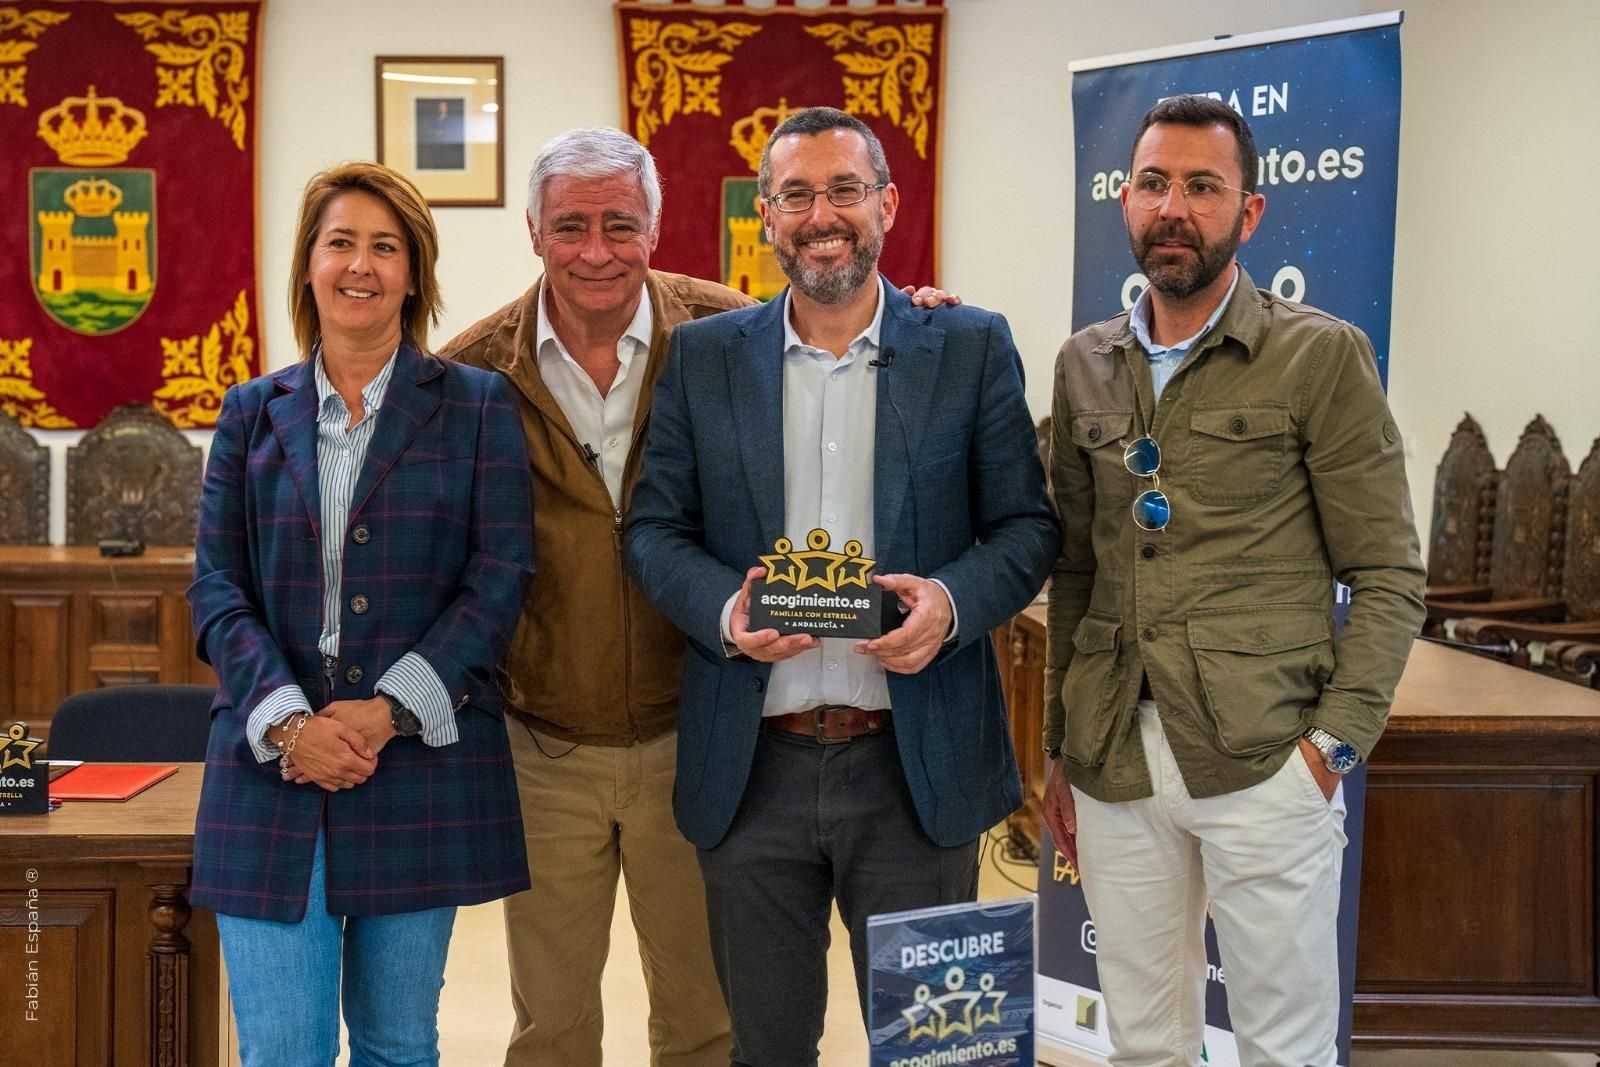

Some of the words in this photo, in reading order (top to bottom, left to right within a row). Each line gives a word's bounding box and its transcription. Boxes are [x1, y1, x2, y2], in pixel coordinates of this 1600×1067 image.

[1252, 82, 1289, 117] EN
[761, 593, 871, 609] acogimiento.es
[770, 609, 804, 618] FAMILIAS
[823, 612, 858, 620] ESTRELLA
[901, 931, 1005, 969] DESCUBRE
